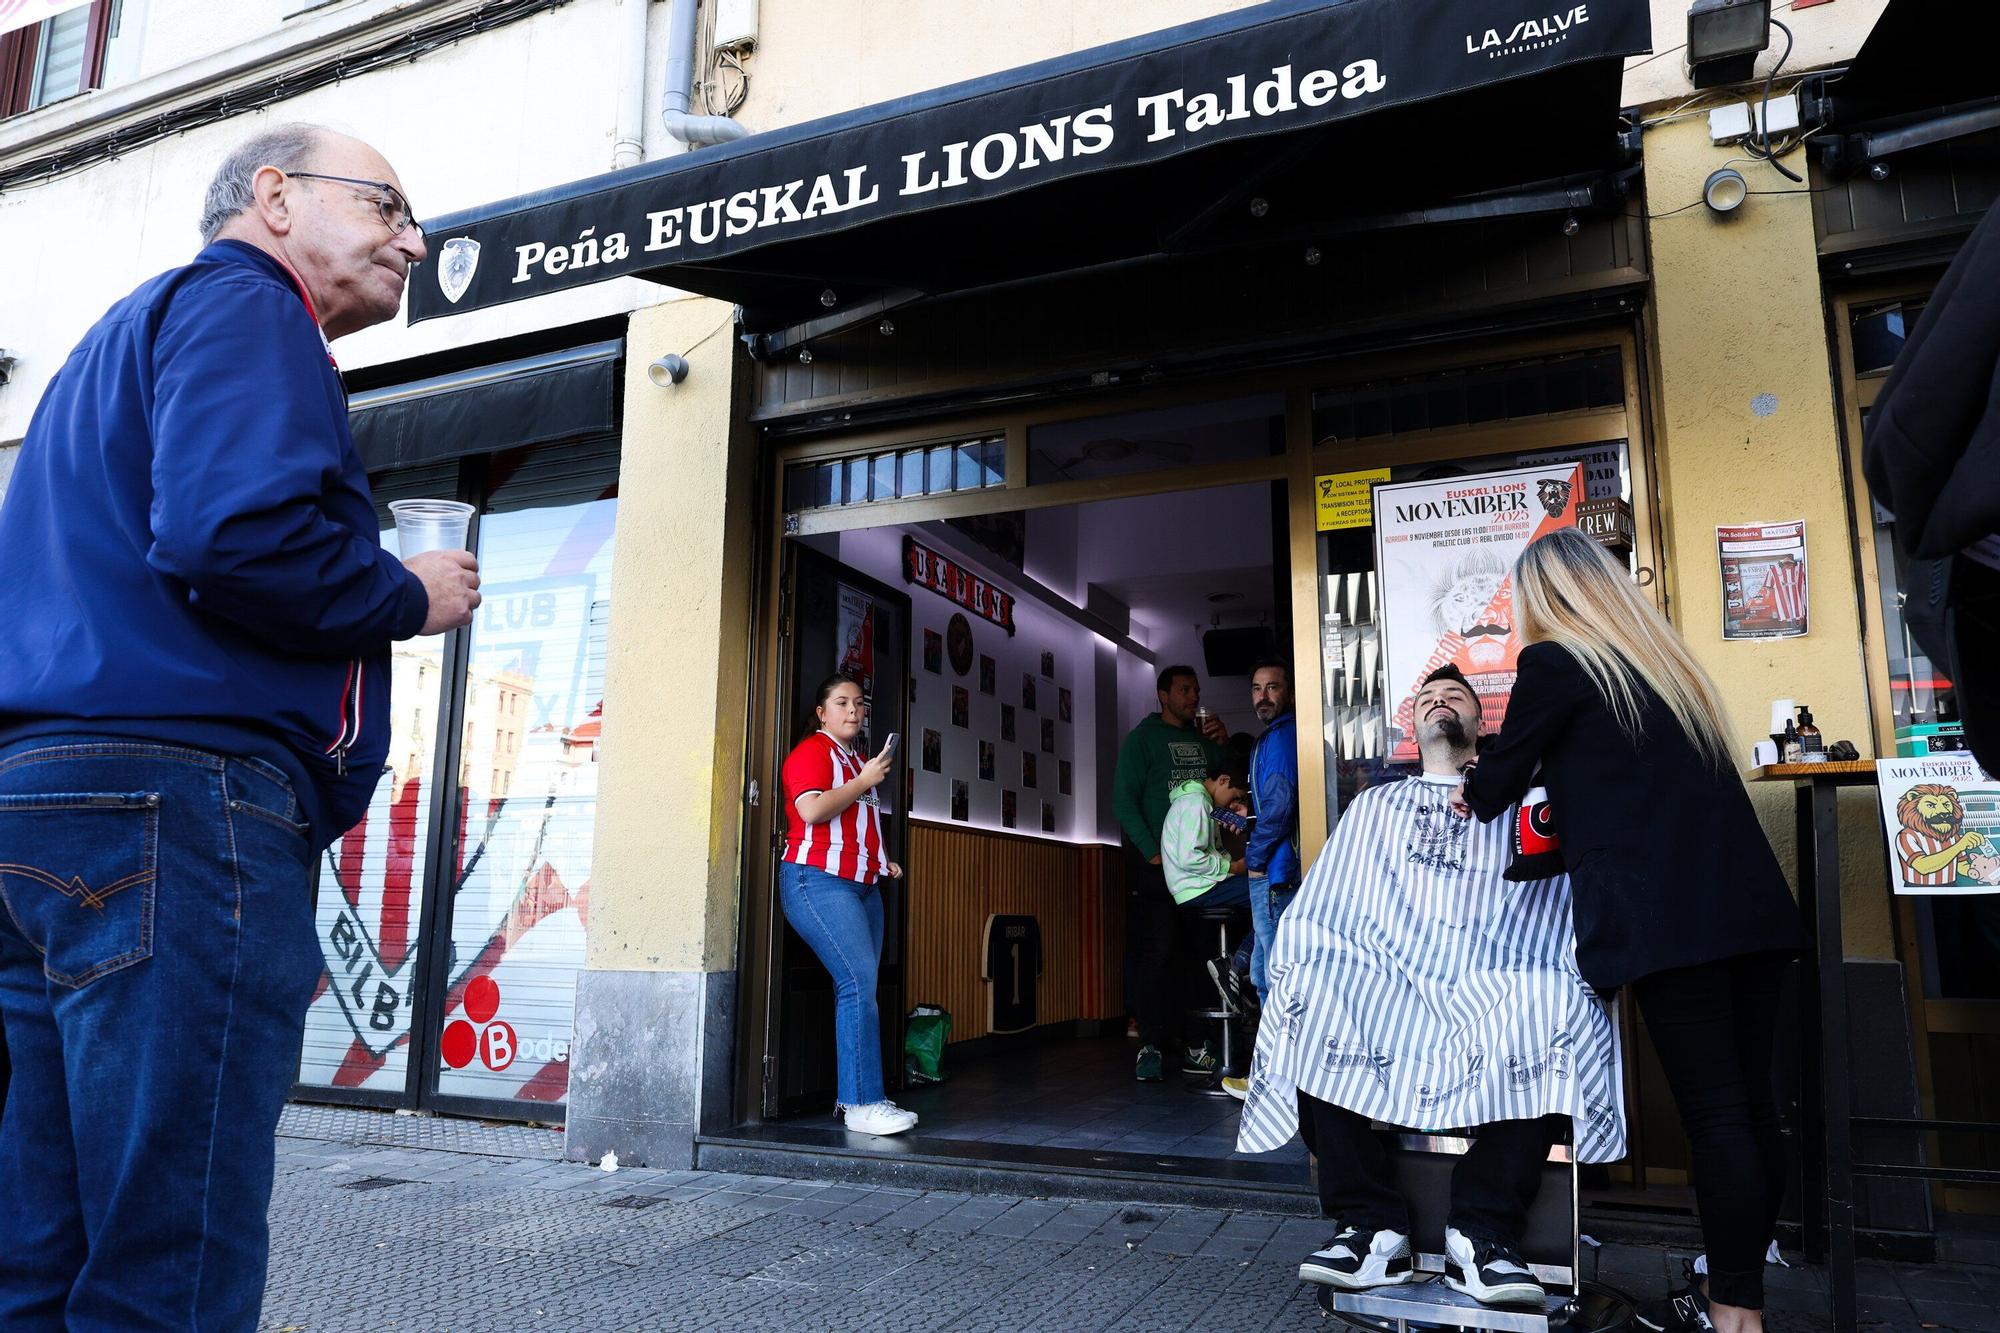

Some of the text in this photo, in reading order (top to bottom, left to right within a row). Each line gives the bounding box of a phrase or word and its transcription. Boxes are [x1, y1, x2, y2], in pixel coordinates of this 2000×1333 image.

[1466, 4, 1589, 54] LA SALVE
[511, 58, 1387, 284] Peña EUSKAL LIONS Taldea
[1446, 482, 1527, 499] EUSKAL LIONS
[1396, 492, 1528, 523] MOVEMBER
[1577, 502, 1615, 512] AMERICAN
[1414, 531, 1443, 541] NOVIEMBRE
[1444, 529, 1461, 538] DESDE
[1462, 528, 1472, 536] LAS
[1433, 539, 1456, 548] ATHLETIC
[1457, 538, 1471, 546] CLUB
[1471, 536, 1479, 544] VS
[1480, 535, 1493, 543] REAL
[1493, 533, 1514, 541] OVIEDO
[484, 593, 557, 631] LUB
[1171, 767, 1207, 780] MUSIC
[1891, 765, 1973, 779] MOVEMBER
[1952, 774, 1974, 782] 2025
[1011, 943, 1021, 1005] 1
[487, 1024, 568, 1068] Bode
